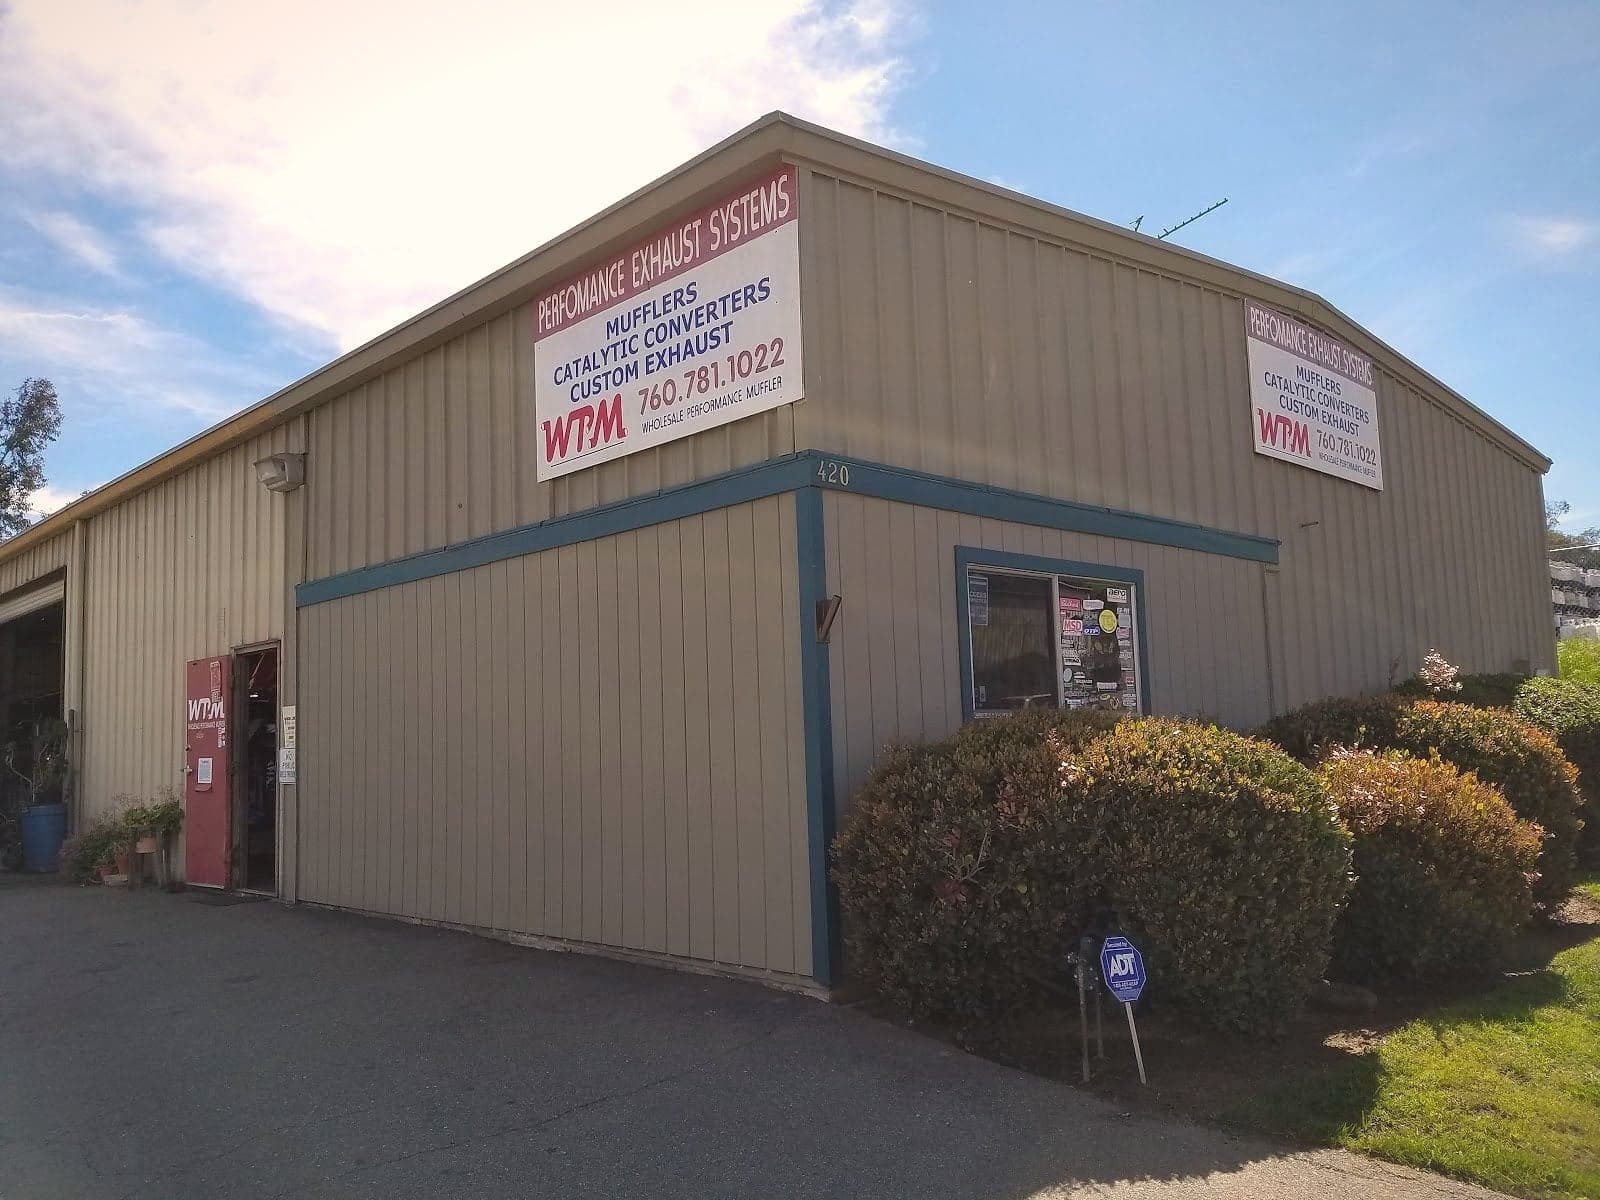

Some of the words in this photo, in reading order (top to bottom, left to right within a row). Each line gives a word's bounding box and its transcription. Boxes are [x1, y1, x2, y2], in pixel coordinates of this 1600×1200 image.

[538, 259, 625, 333] PERFOMANCE
[632, 219, 701, 288] EXHAUST
[710, 174, 790, 250] SYSTEMS
[553, 334, 639, 386] CATALYTIC
[644, 276, 771, 348] CONVERTERS
[606, 281, 698, 340] MUFFLERS
[570, 359, 639, 402] CUSTOM
[645, 320, 734, 375] EXHAUST
[1250, 306, 1307, 354] PERFOMANCE
[1308, 332, 1341, 369] EXHAUST
[1343, 350, 1372, 386] SYSTEMS
[638, 337, 785, 415] 760.781.1022
[1264, 371, 1316, 401] CATALYTIC
[1317, 391, 1370, 424] CONVERTERS
[1296, 364, 1342, 396] MUFFLERS
[541, 393, 628, 463] WPM
[641, 410, 684, 434] WHOLESALE
[686, 389, 742, 419] PERFORMANCE
[746, 375, 783, 400] MUFFLER
[1257, 407, 1312, 458] WPM
[1279, 394, 1320, 423] CUSTOM
[1321, 410, 1360, 437] EXHAUST
[817, 460, 849, 486] 420
[1316, 428, 1377, 466] 760.781.1022
[1063, 619, 1082, 631] MSD
[1110, 953, 1135, 977] ADT
